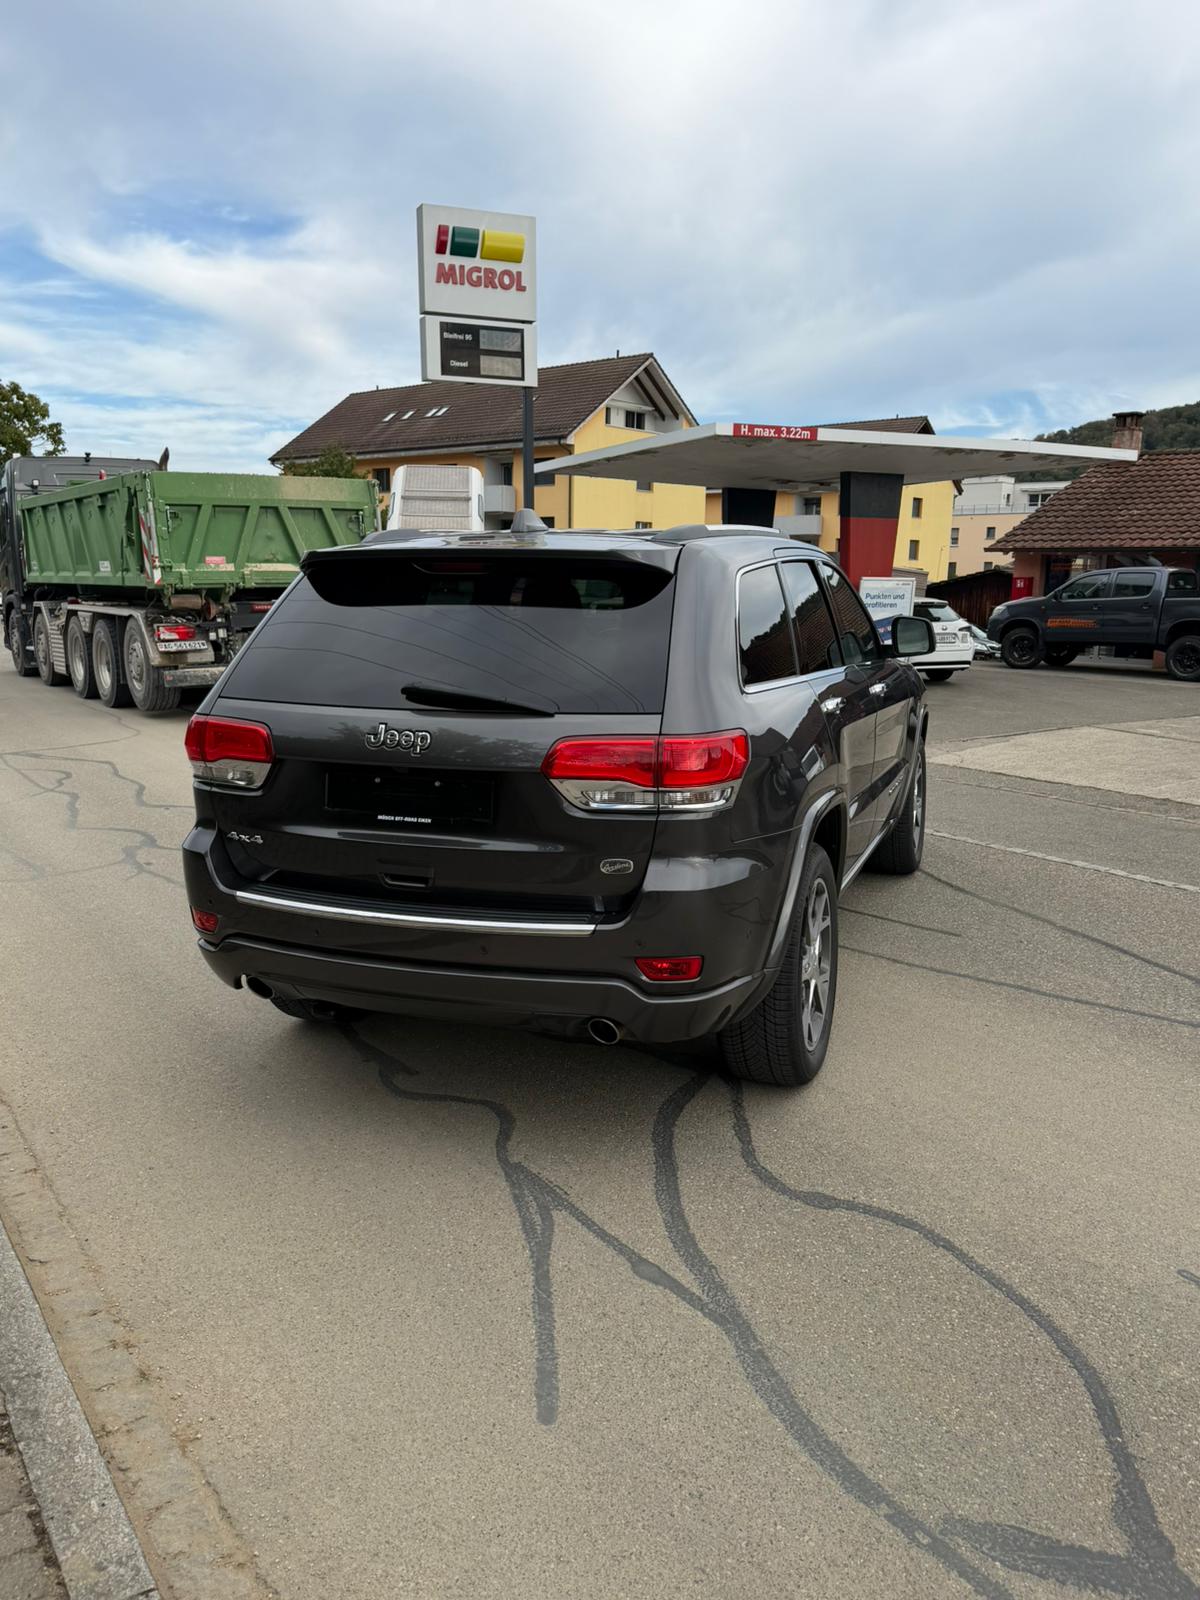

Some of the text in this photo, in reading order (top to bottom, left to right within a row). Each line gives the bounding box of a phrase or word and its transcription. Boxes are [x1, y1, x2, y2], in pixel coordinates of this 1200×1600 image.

[435, 262, 527, 292] MIGROL
[443, 331, 473, 341] Bleifrei 95
[449, 359, 469, 368] Diesel
[740, 424, 811, 439] H. max. 3.22m
[865, 592, 892, 600] Punkten
[364, 722, 431, 756] Jeep
